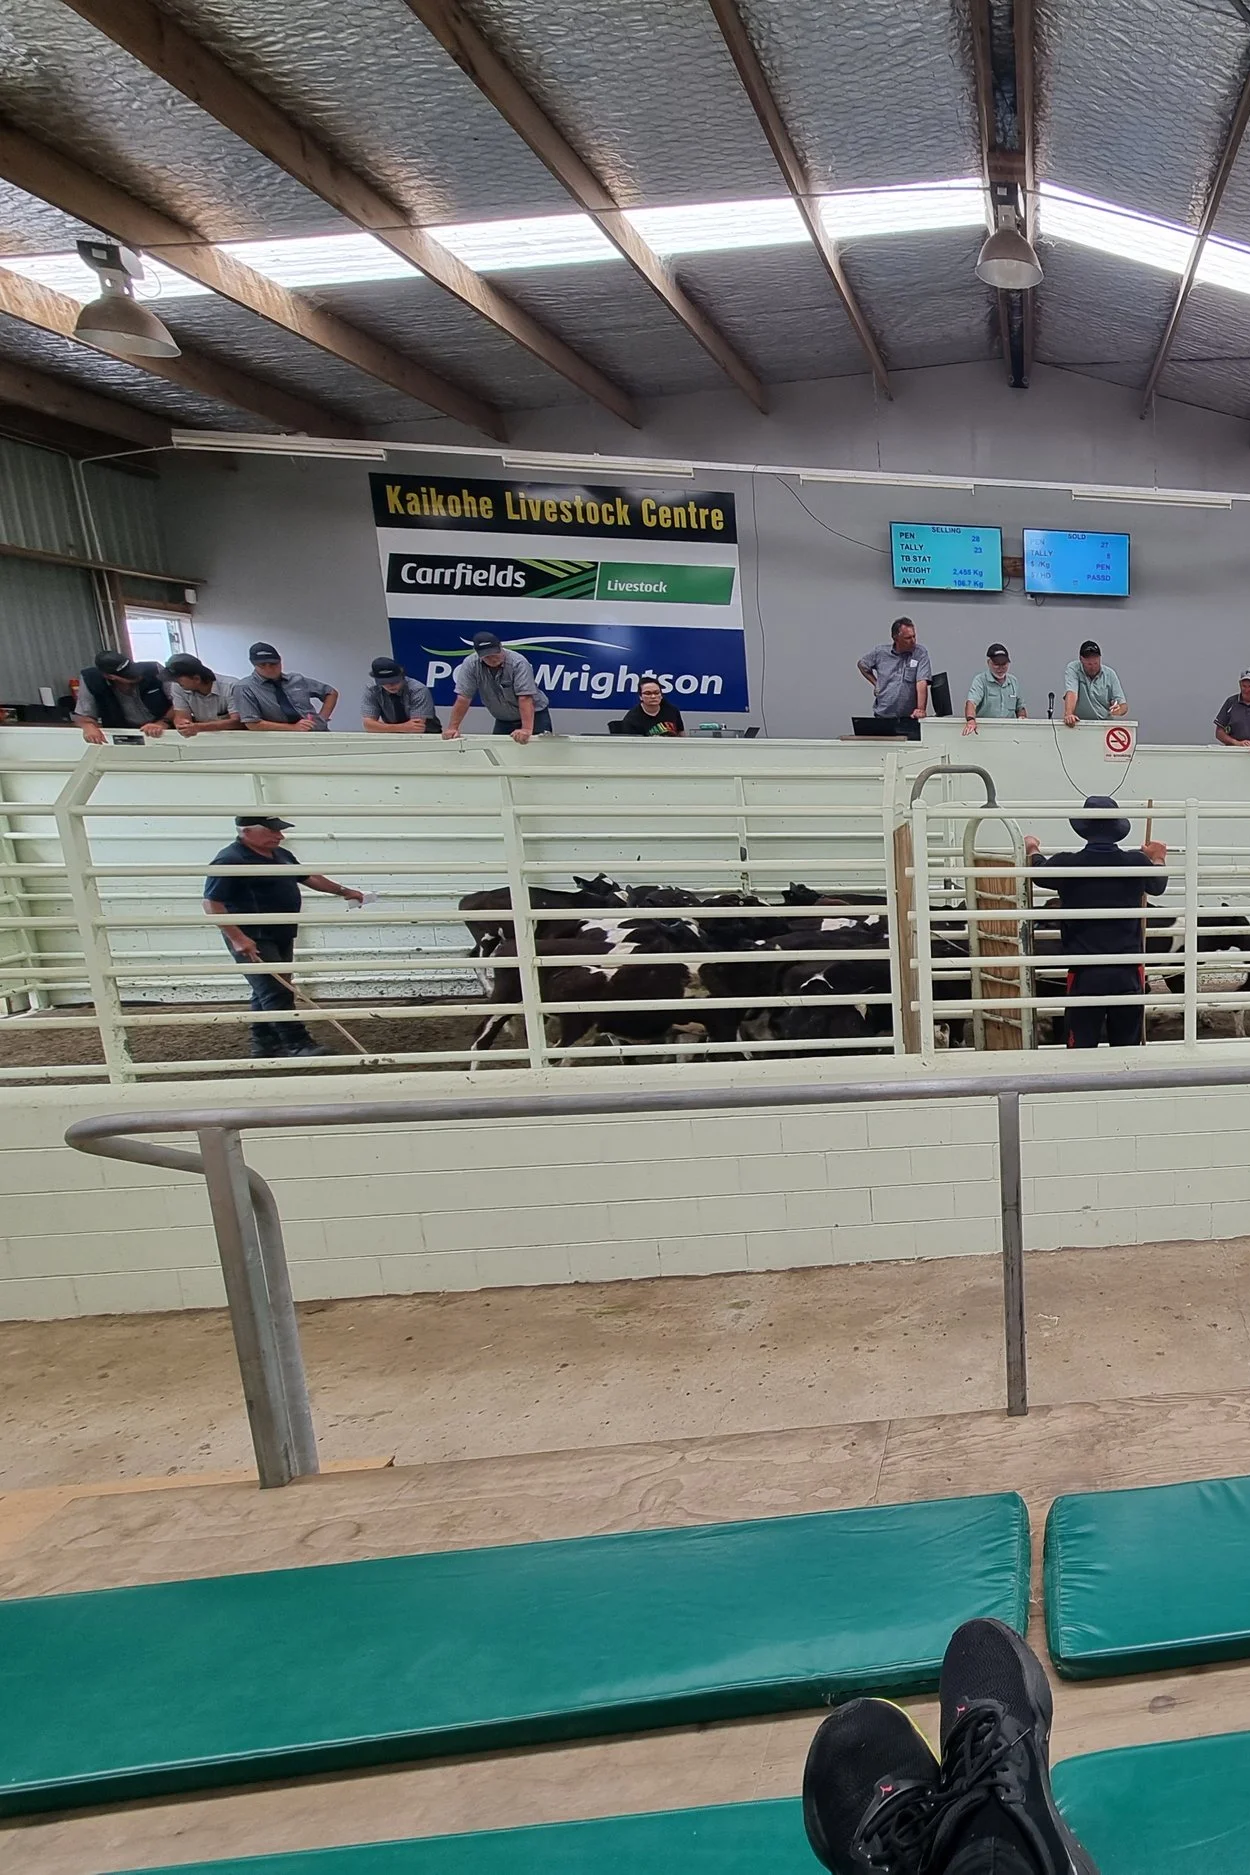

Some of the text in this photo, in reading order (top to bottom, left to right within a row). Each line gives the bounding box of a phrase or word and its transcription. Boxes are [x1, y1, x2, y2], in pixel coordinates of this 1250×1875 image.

[386, 484, 724, 531] Kaikohe Livestock Centre
[931, 526, 961, 534] SELLING
[900, 543, 924, 551] TALLY
[1030, 549, 1054, 557] TALLY
[400, 562, 526, 590] Carrfields
[607, 579, 668, 593] Livestock
